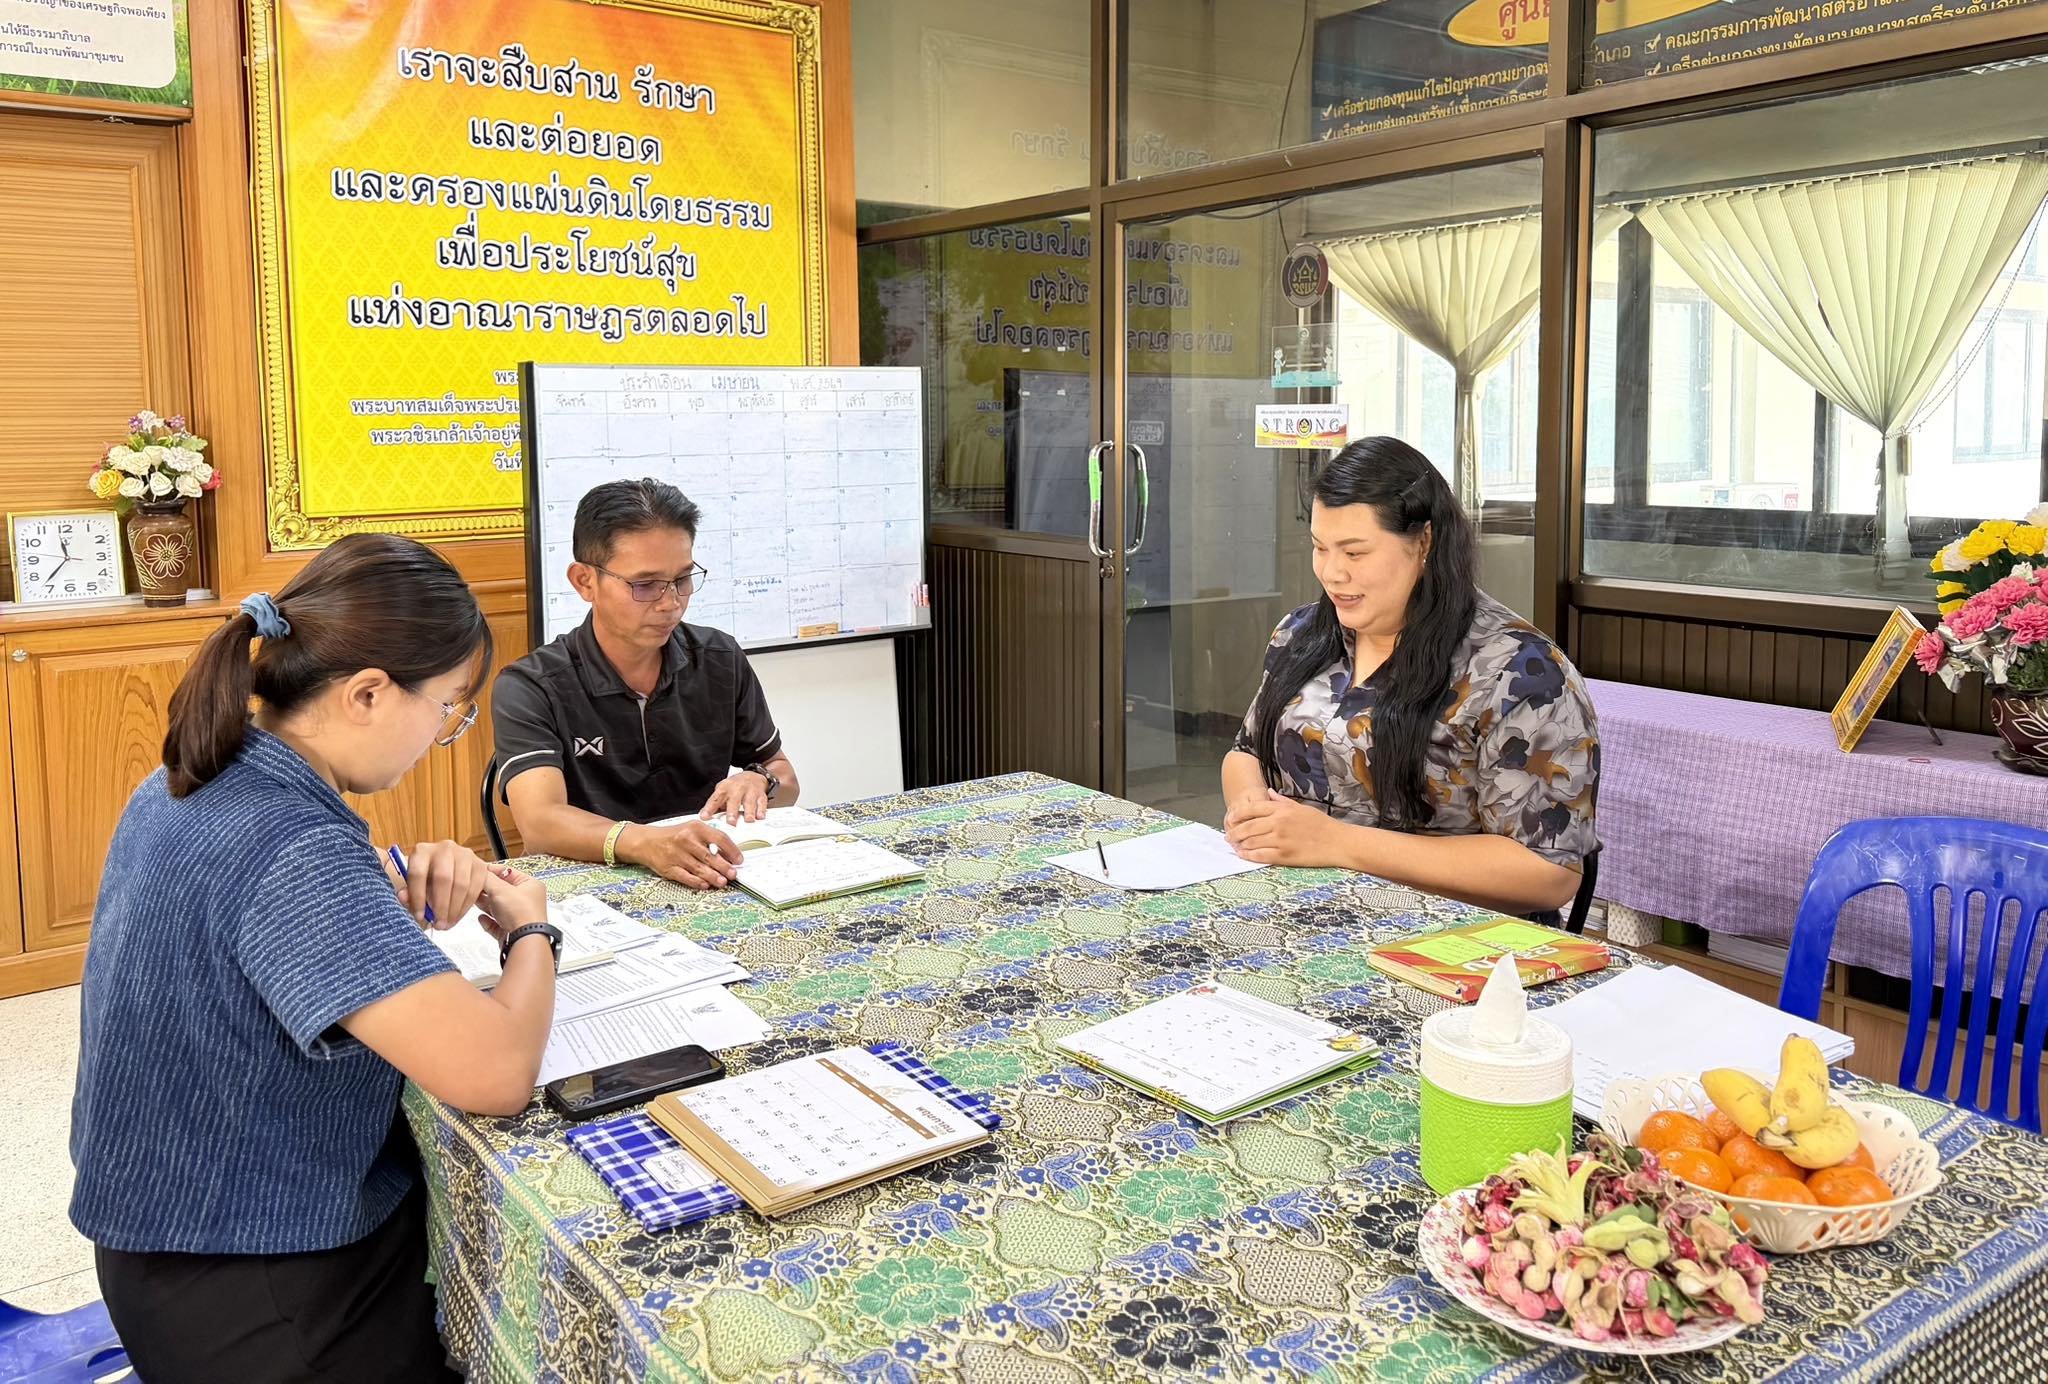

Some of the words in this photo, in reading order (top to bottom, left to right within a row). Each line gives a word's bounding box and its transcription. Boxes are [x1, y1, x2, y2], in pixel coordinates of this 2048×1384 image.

[400, 46, 618, 101] เราจะสืบสาน
[634, 67, 714, 113] รักษา
[471, 114, 661, 164] และต่อยอด
[333, 168, 771, 230] และครองแผ่นดินโดยธรรม
[439, 212, 697, 294] เพื่อประโยชน์สุข
[350, 285, 767, 342] แห่งอาณาราษฎรตลอดไป
[711, 375, 760, 390] เมษายน
[351, 393, 520, 414] พระบาทสมเด็จพระปรเ
[37, 525, 46, 535] 11
[58, 524, 73, 534] 12
[26, 538, 42, 548] 10
[94, 535, 106, 544] 2
[28, 556, 40, 565] 9
[96, 552, 107, 561] 3
[29, 572, 40, 582] 8
[98, 568, 108, 576] 4
[45, 584, 54, 594] 7
[64, 583, 76, 592] 6
[86, 582, 98, 591] 5
